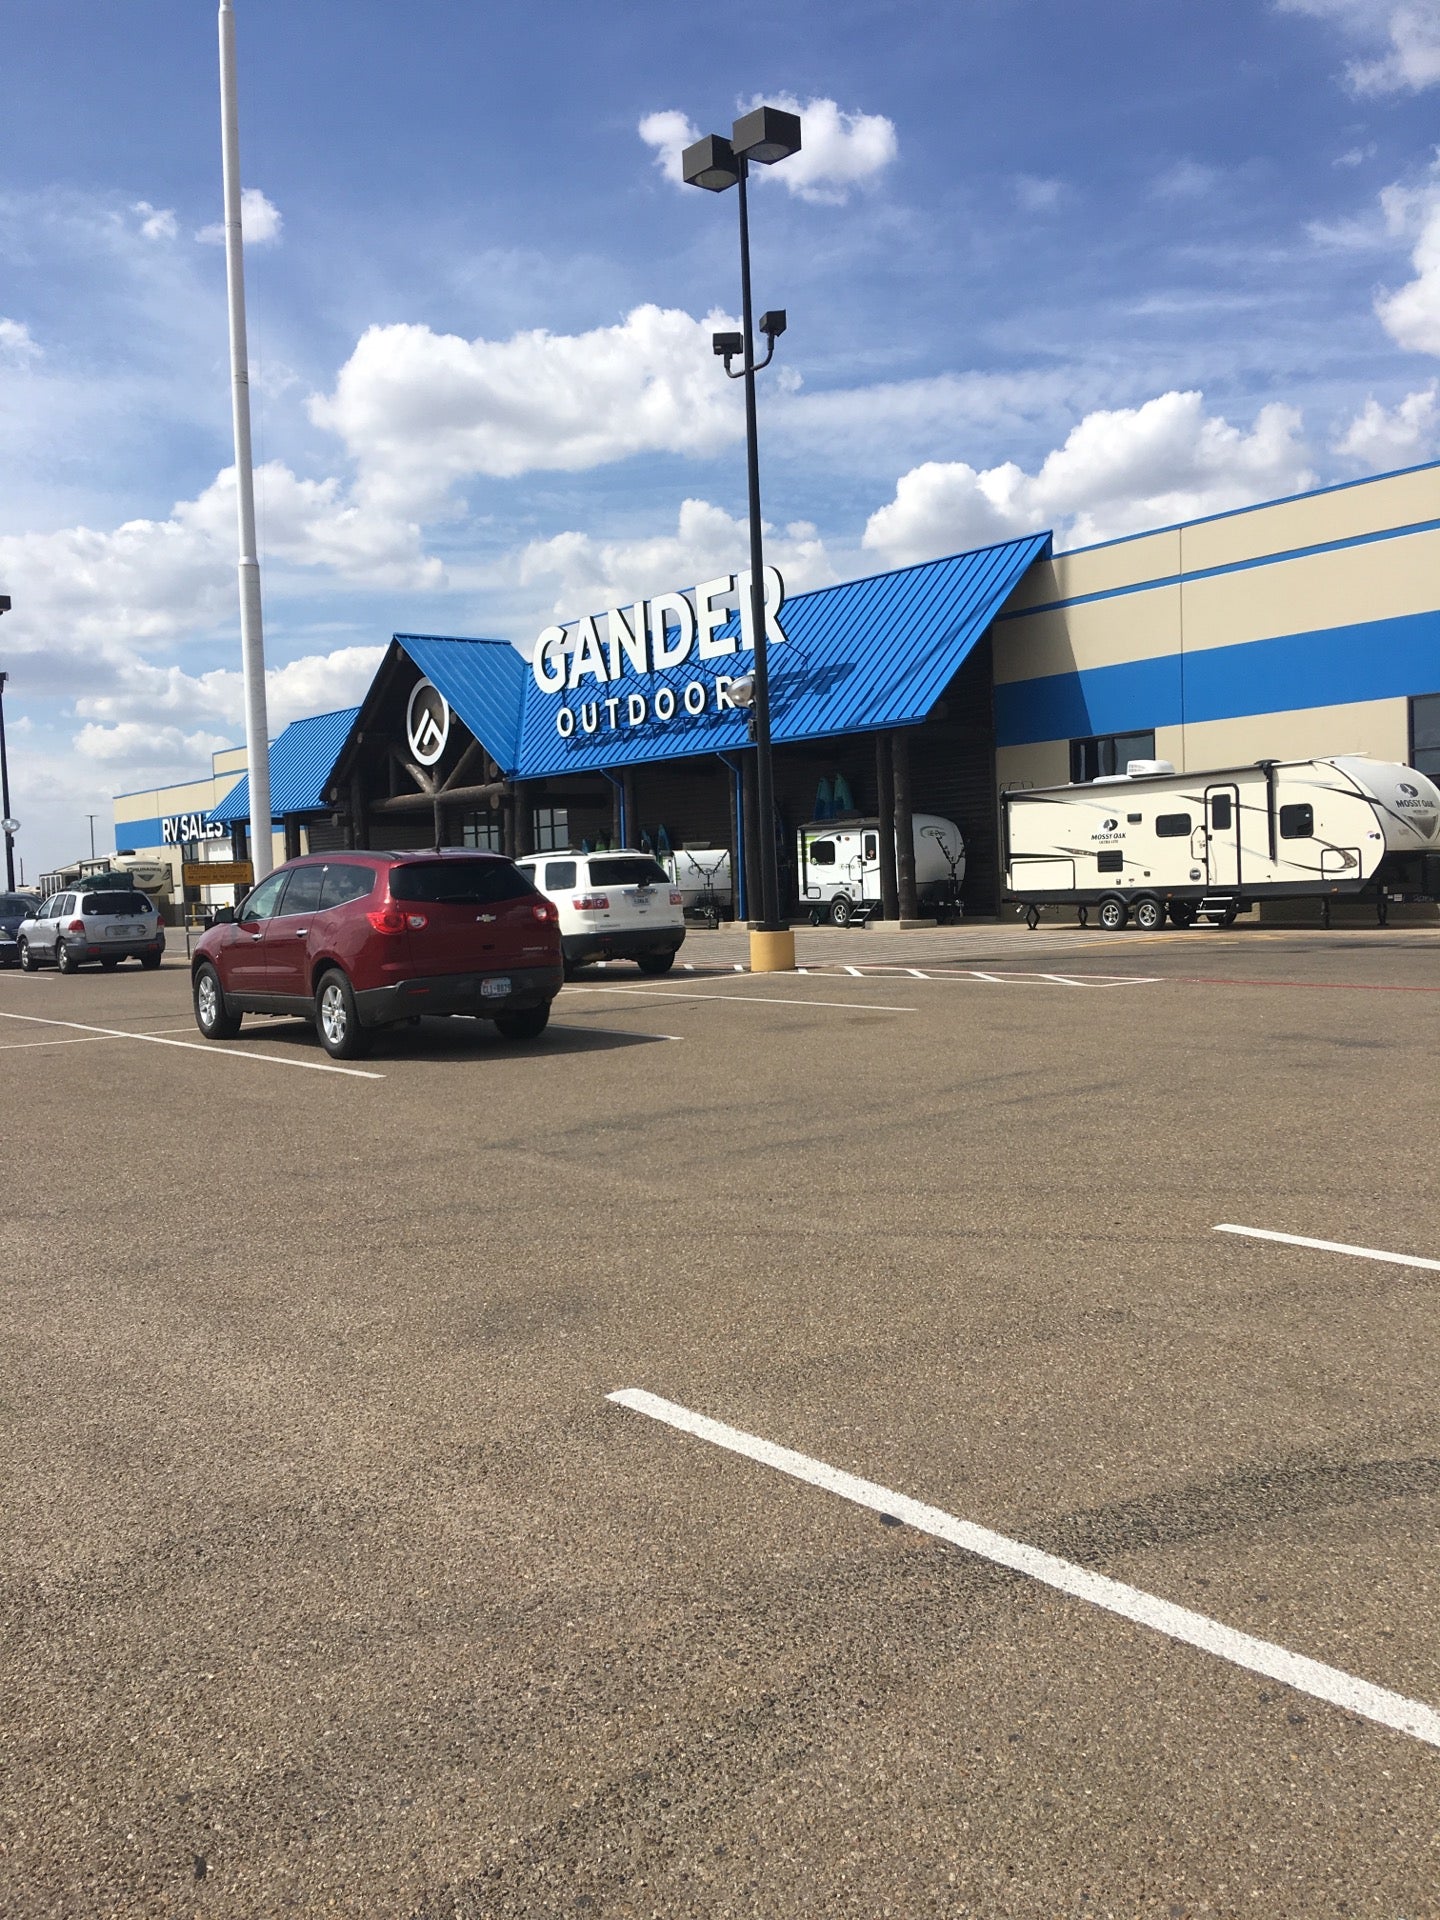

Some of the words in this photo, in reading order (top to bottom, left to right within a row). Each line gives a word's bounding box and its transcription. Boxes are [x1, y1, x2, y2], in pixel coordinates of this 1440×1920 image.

[532, 565, 789, 694] GANDER
[556, 669, 757, 738] OUTDOOR
[1395, 800, 1421, 808] MOSSY
[162, 817, 179, 842] RV
[1091, 832, 1113, 840] MOSSY
